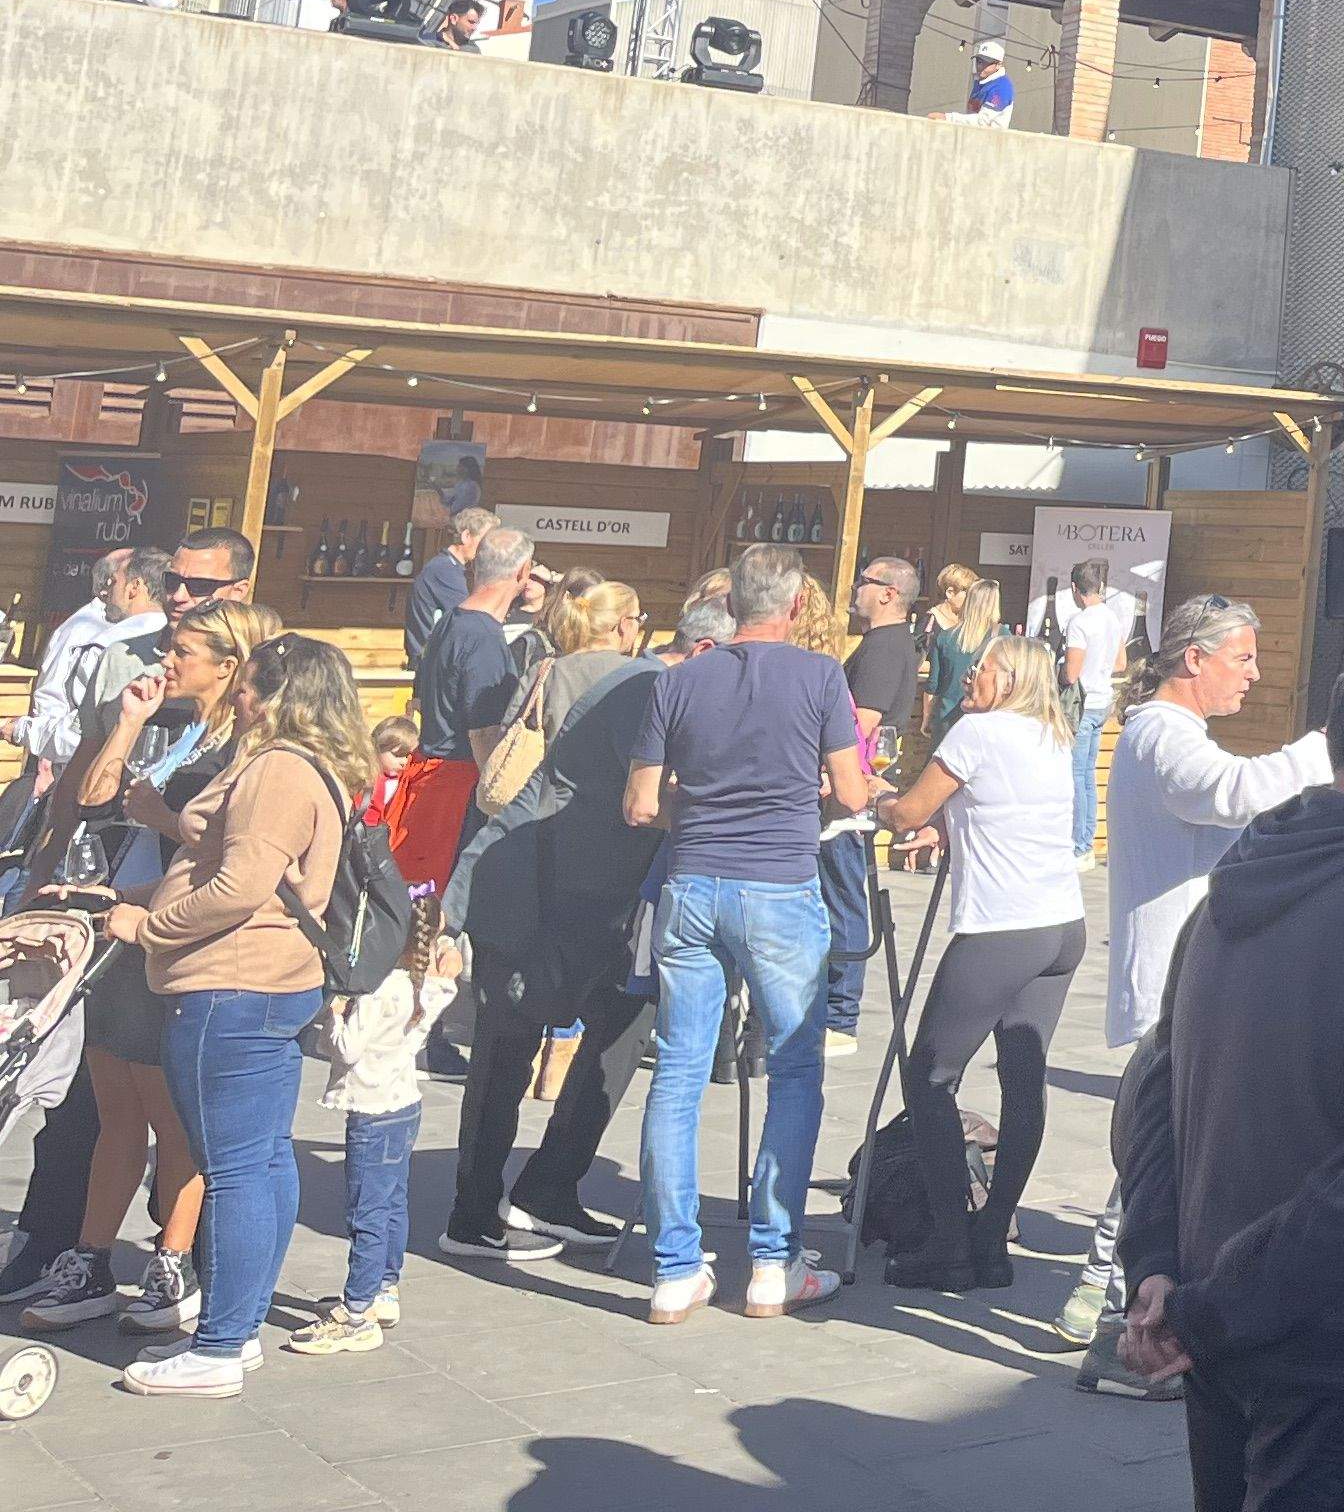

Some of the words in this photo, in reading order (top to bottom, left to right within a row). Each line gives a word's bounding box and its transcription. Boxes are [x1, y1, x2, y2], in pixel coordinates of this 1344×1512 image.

[535, 518, 593, 532] CASTELL
[597, 520, 631, 534] D'OR
[1008, 544, 1030, 556] SAT
